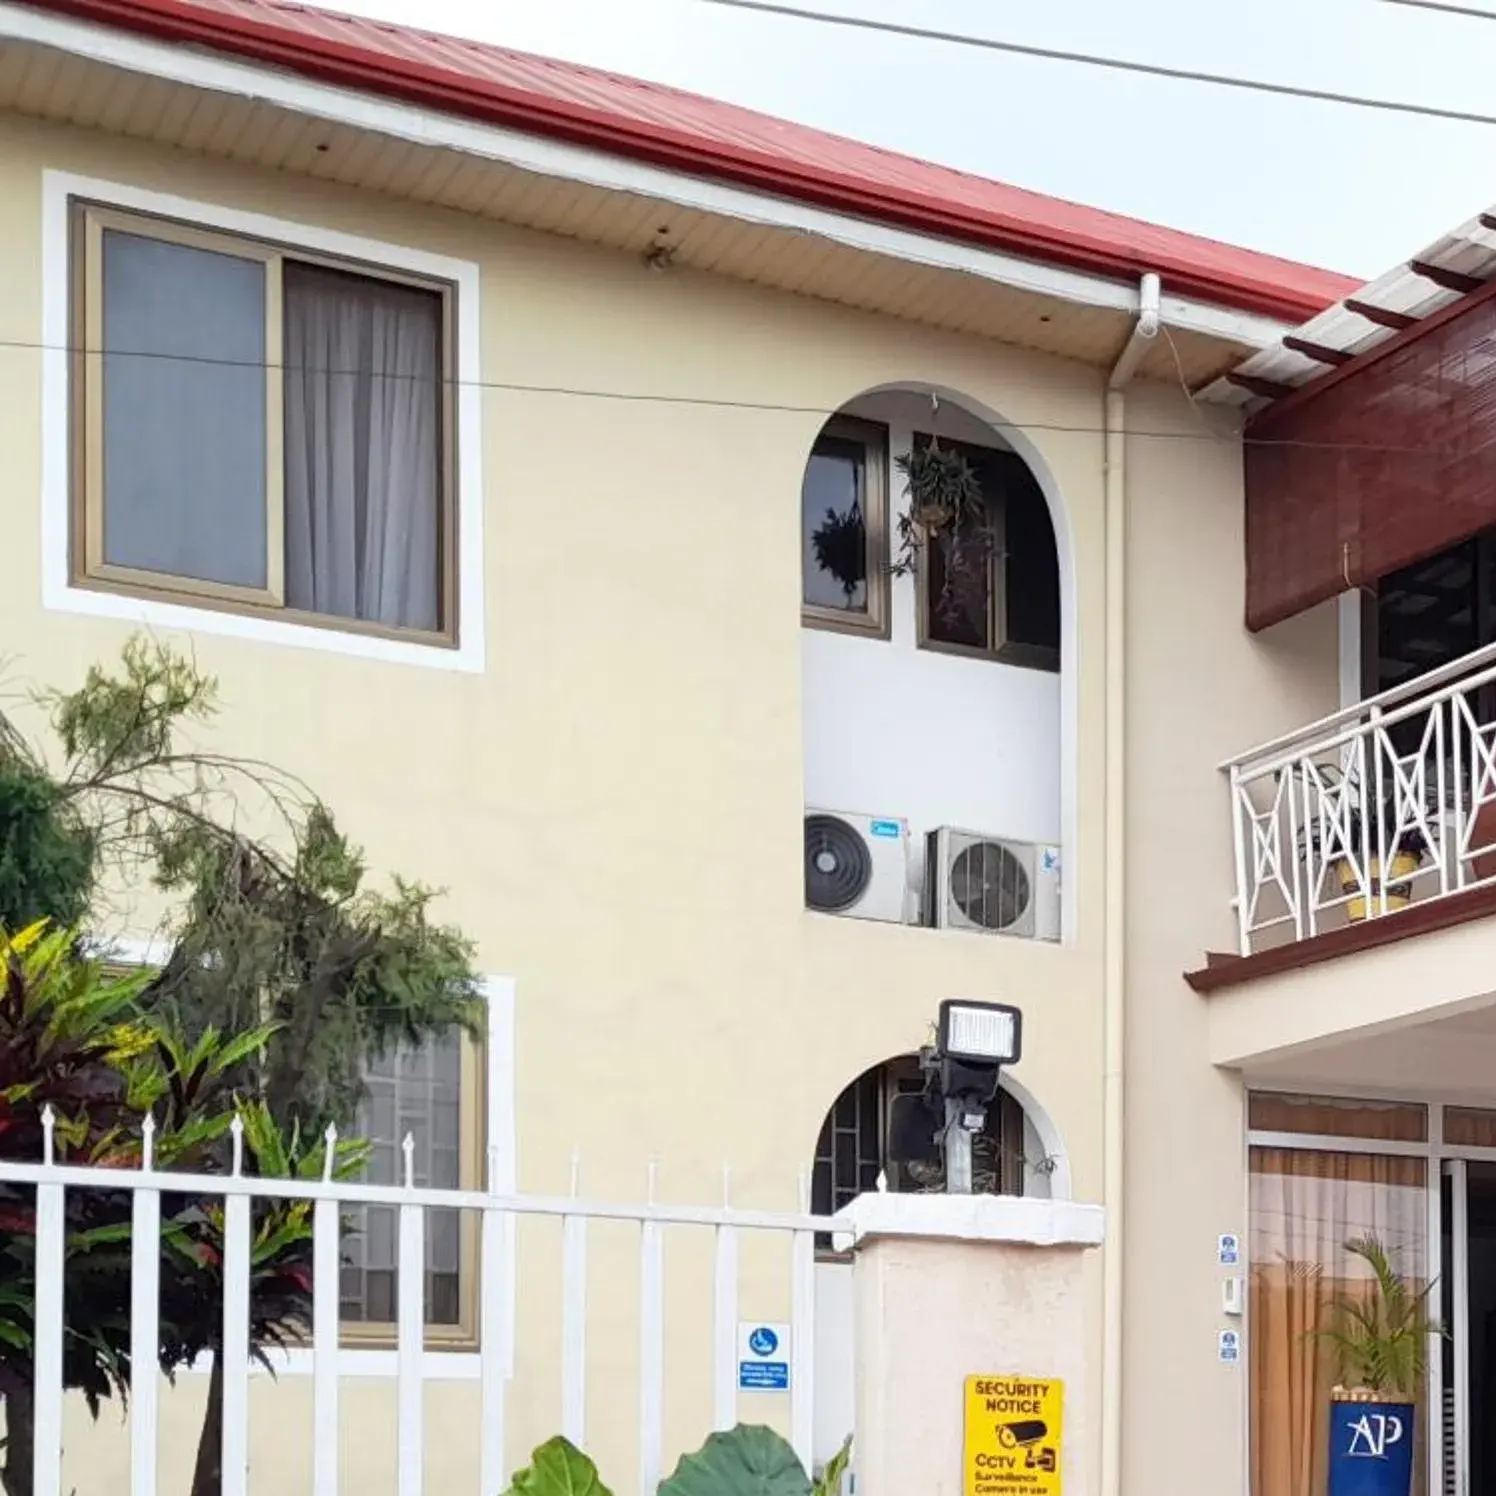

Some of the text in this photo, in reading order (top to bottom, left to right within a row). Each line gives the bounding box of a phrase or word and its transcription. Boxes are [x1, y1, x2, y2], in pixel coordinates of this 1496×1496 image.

[975, 1380, 1050, 1398] SECURITY
[986, 1399, 1041, 1414] NOTICE
[975, 1453, 1016, 1468] CCTV
